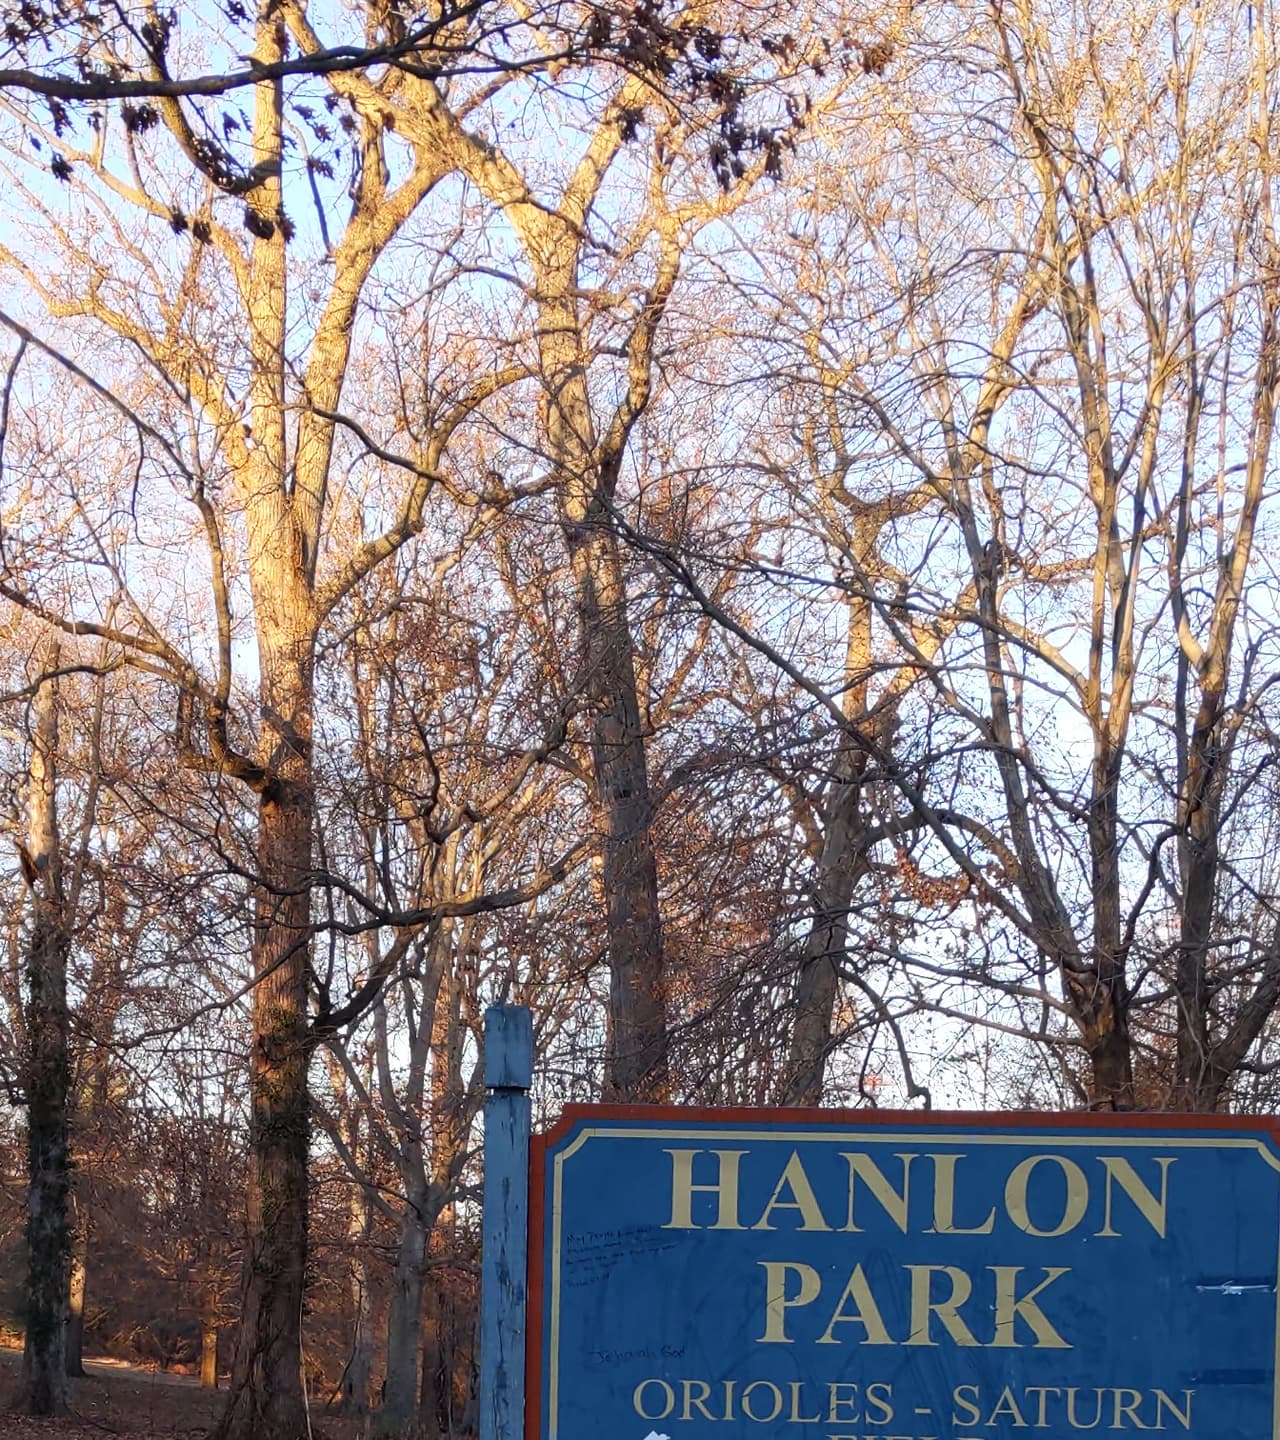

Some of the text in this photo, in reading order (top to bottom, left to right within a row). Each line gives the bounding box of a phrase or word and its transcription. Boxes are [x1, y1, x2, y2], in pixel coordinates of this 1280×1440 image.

[661, 1148, 1180, 1238] HANLON
[756, 1261, 1075, 1349] PARK
[632, 1378, 894, 1425] ORIOLES
[951, 1385, 1196, 1431] SATURN
